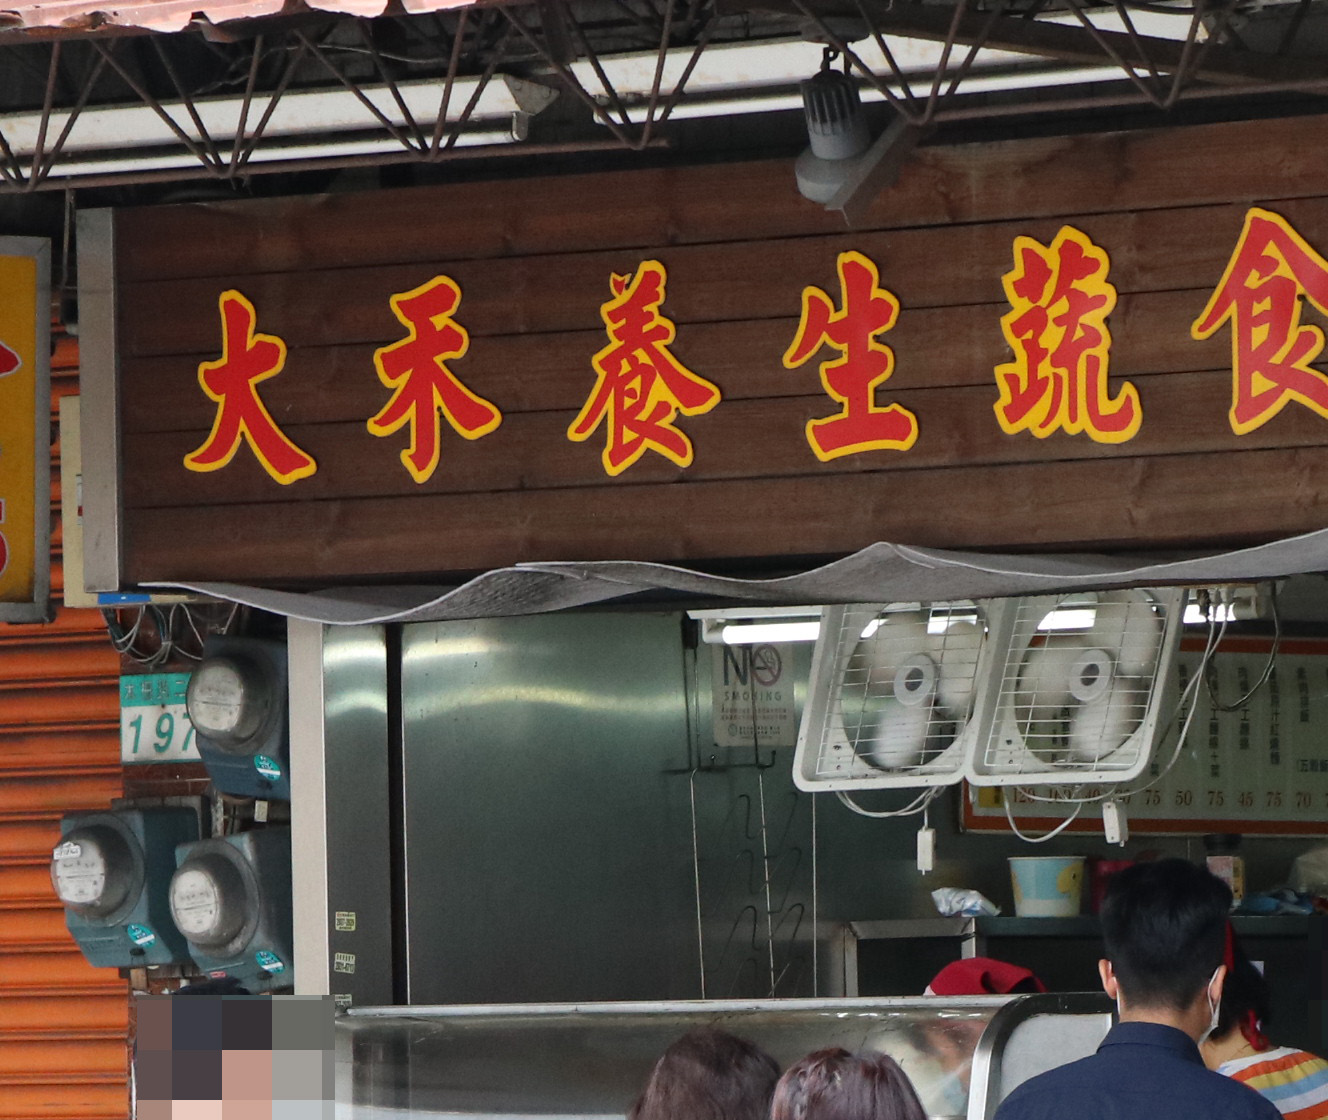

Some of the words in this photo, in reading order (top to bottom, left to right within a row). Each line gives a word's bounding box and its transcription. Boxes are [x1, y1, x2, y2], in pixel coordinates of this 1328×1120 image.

[130, 712, 195, 753] 197
[1175, 790, 1192, 806] 50
[1208, 790, 1224, 807] 75
[1266, 791, 1283, 807] 75
[1296, 792, 1312, 808] 70
